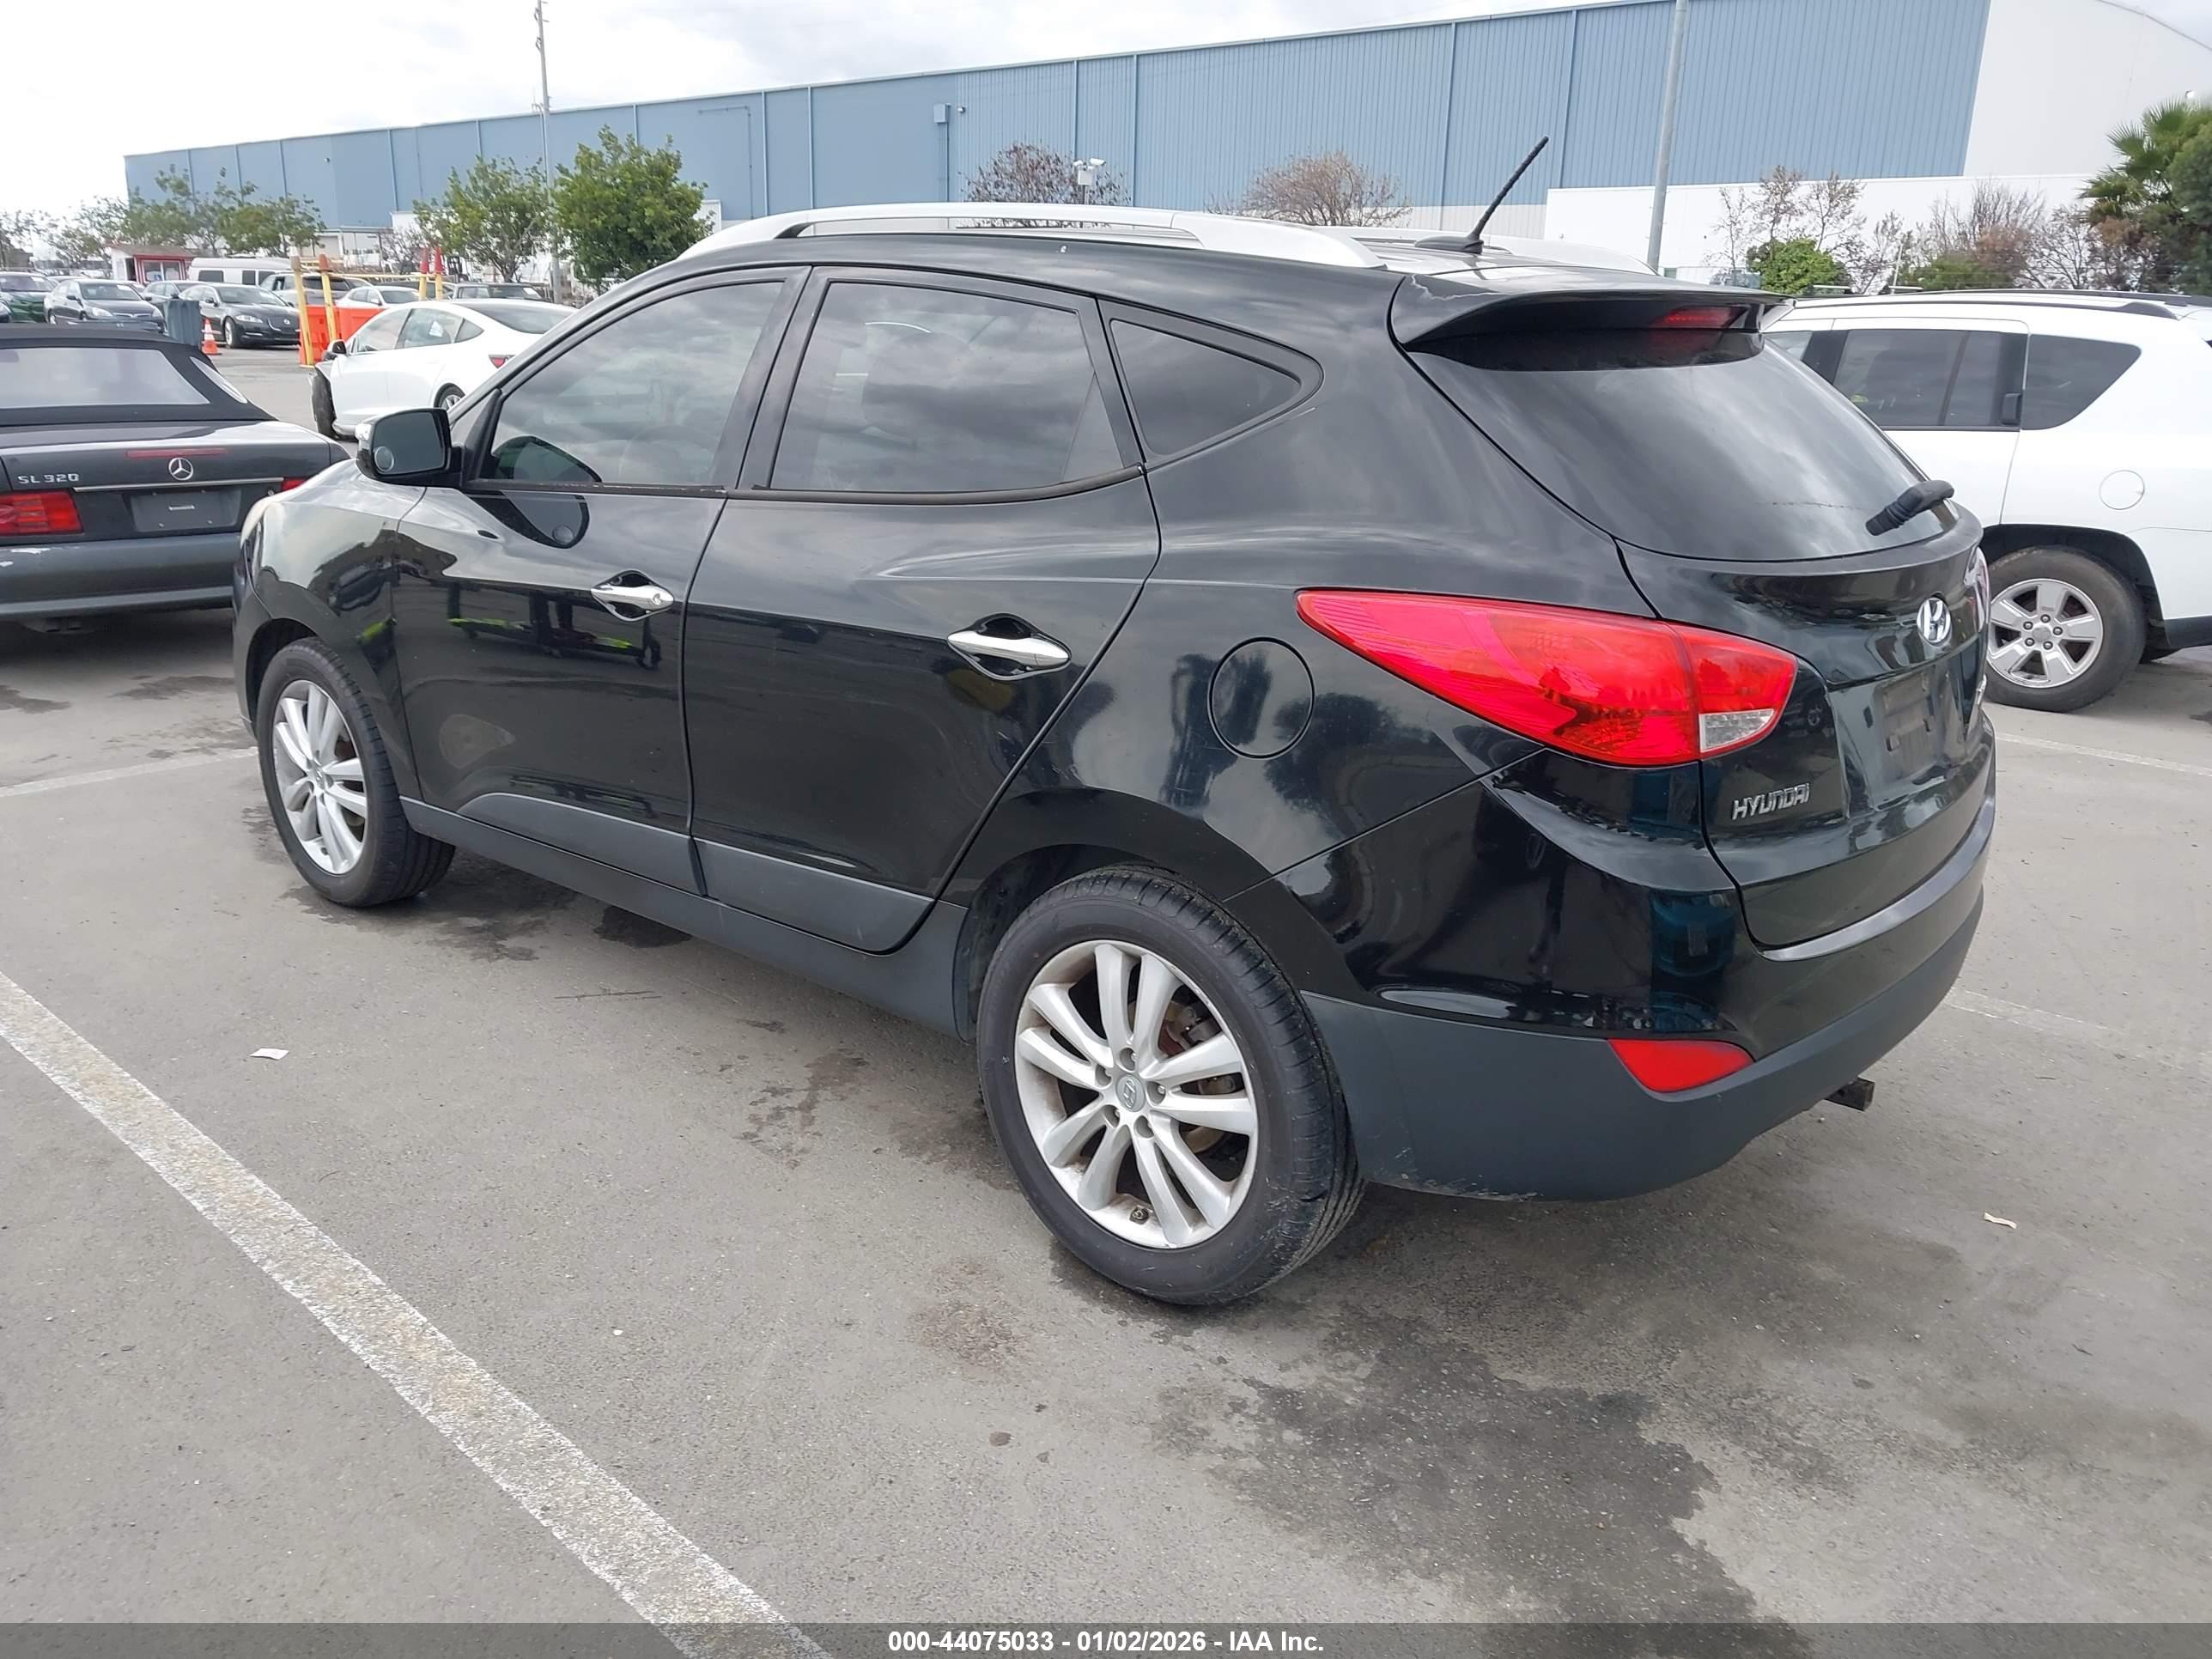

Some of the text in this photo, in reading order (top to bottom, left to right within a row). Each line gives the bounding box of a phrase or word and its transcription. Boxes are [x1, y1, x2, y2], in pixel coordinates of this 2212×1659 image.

[17, 473, 79, 484] SL 320
[1732, 782, 1810, 820] HYUNDAI
